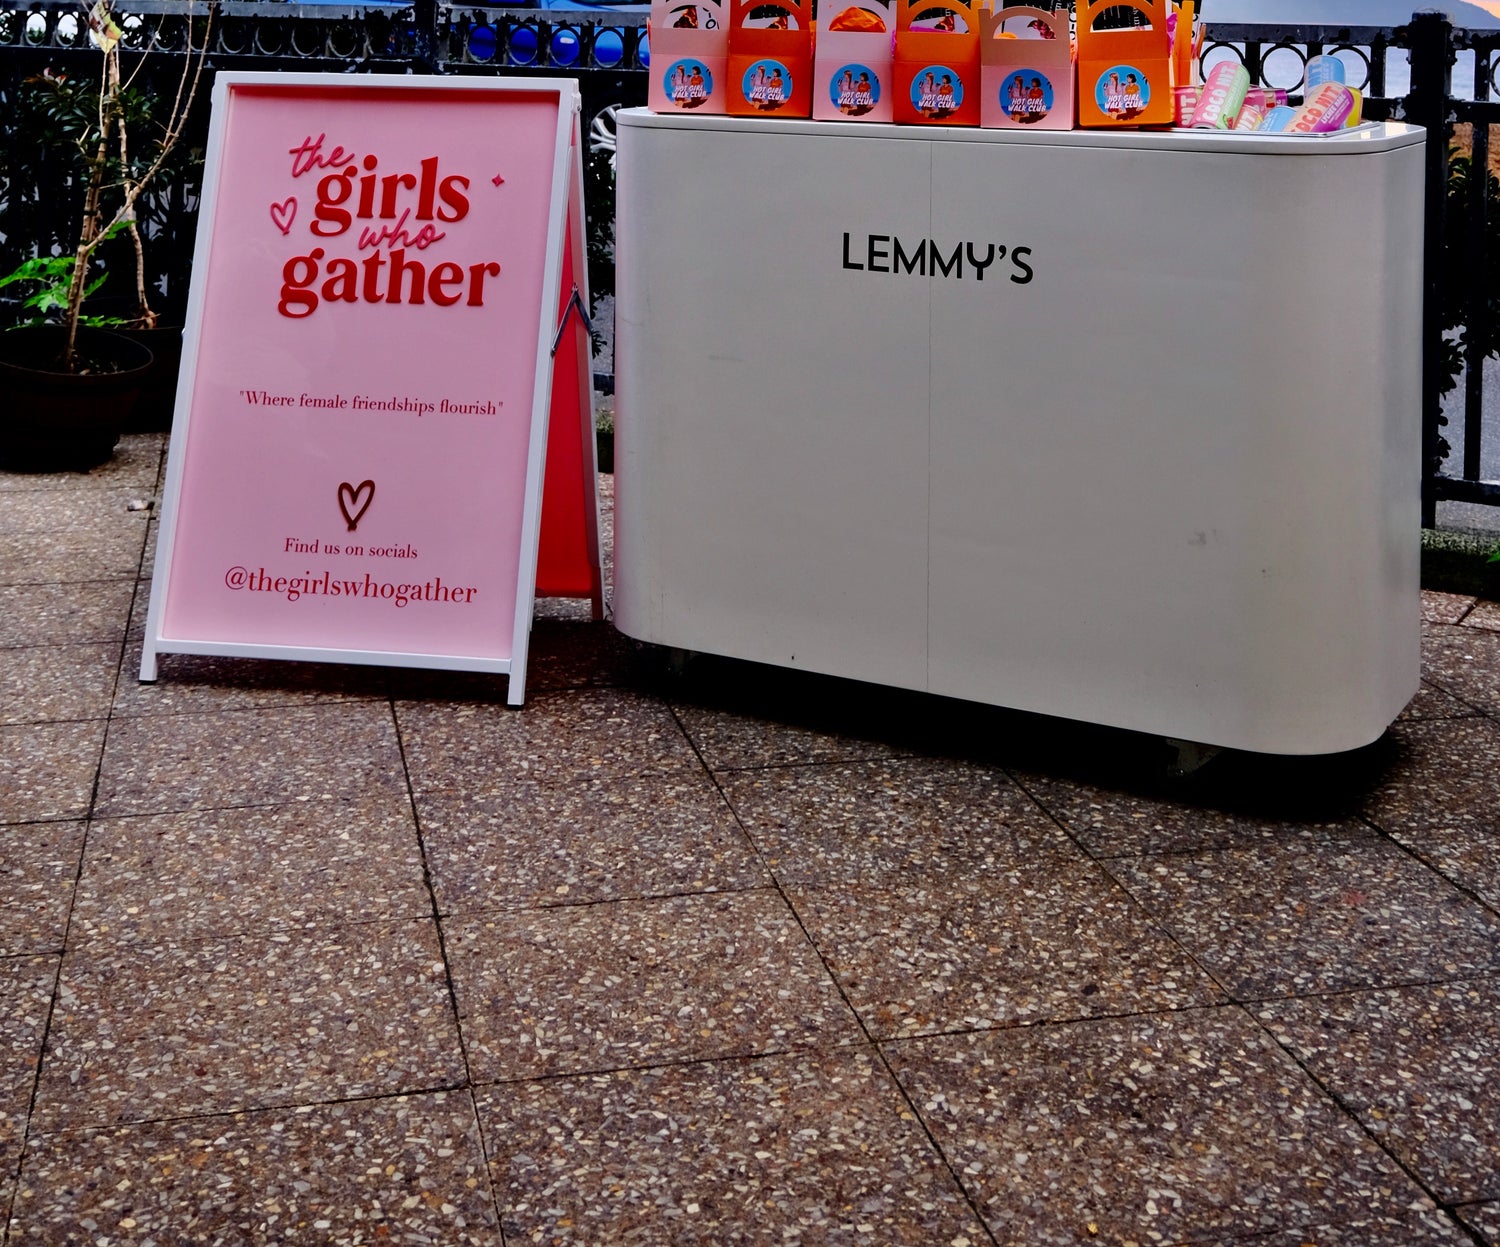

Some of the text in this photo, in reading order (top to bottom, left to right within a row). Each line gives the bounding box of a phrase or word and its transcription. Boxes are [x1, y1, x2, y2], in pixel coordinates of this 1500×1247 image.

[690, 90, 707, 98] CLUB
[749, 92, 767, 100] WALK
[837, 97, 873, 105] WALK CLUB
[918, 100, 955, 108] WALK CLUB
[937, 94, 953, 102] GIRL
[1104, 100, 1143, 109] WALK CLUB
[1123, 94, 1139, 102] GIRL
[1202, 88, 1227, 121] COCO
[1007, 104, 1046, 112] WALK CLUB
[289, 133, 355, 178] the
[310, 155, 470, 237] girls
[358, 207, 446, 250] who
[842, 232, 1034, 285] LEMMY'S
[278, 248, 501, 319] gather
[239, 390, 503, 416] "Where female friendships flourish"
[284, 537, 418, 559] Find us on socials
[225, 565, 478, 608] @thegirlswhogather
